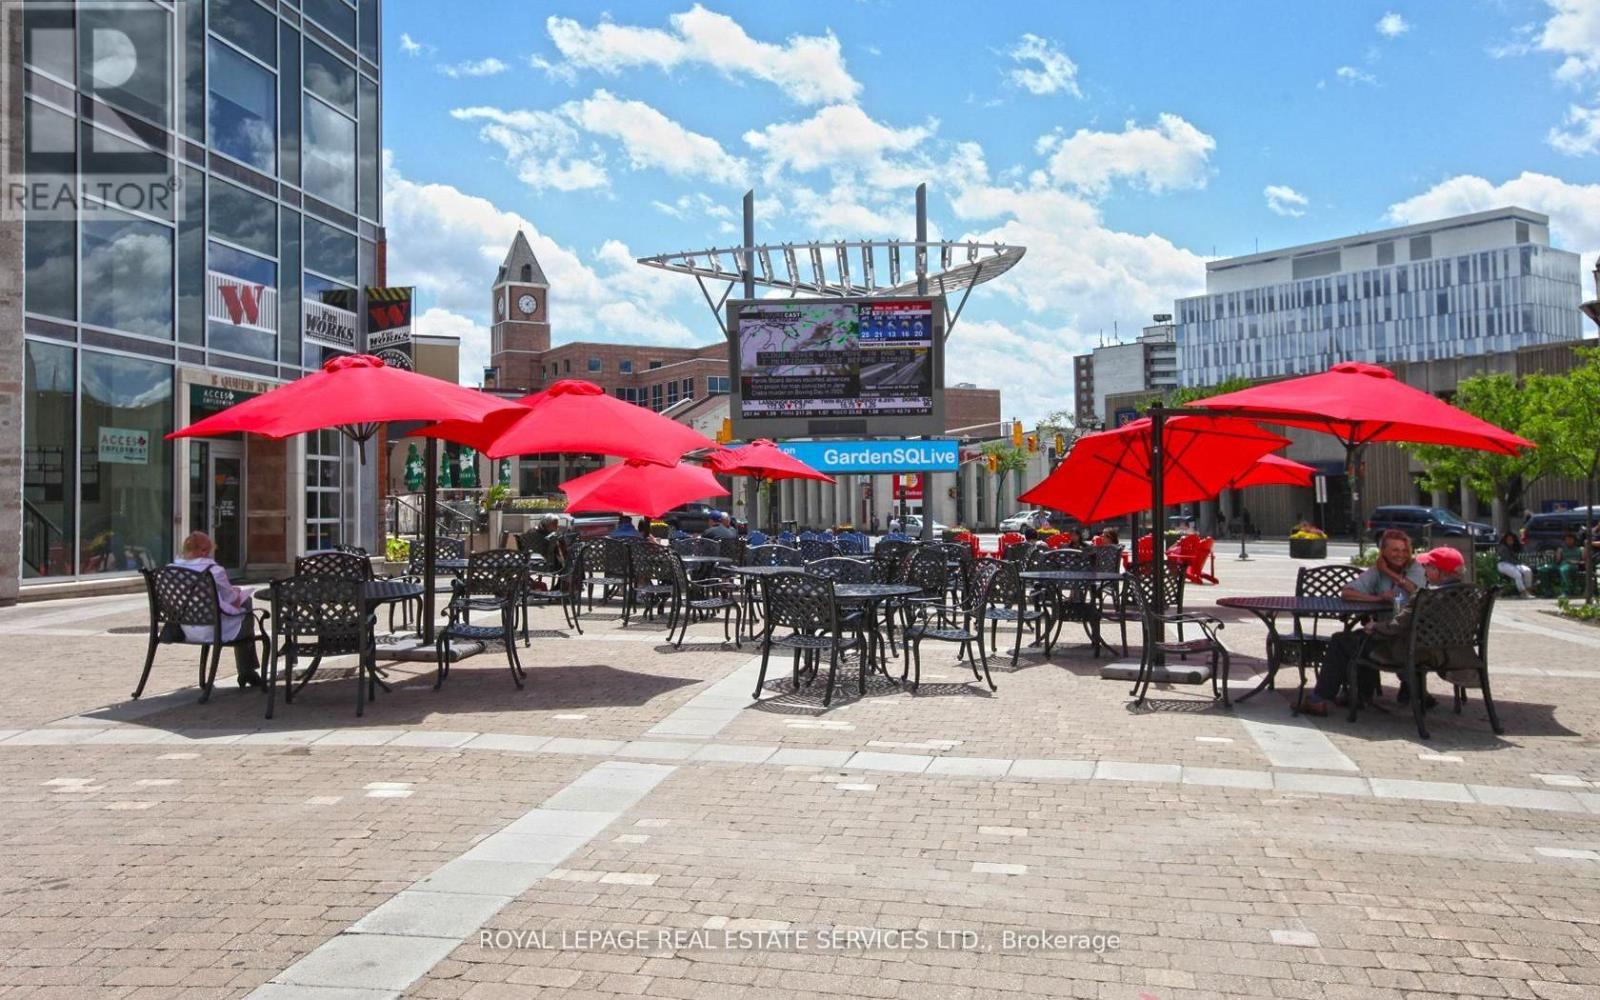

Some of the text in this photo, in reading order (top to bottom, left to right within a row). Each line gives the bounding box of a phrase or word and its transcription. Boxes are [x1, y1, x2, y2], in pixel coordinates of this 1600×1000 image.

[218, 286, 265, 325] W
[369, 302, 408, 330] W
[306, 313, 354, 341] WORKS
[824, 448, 955, 465] GardenSQLive
